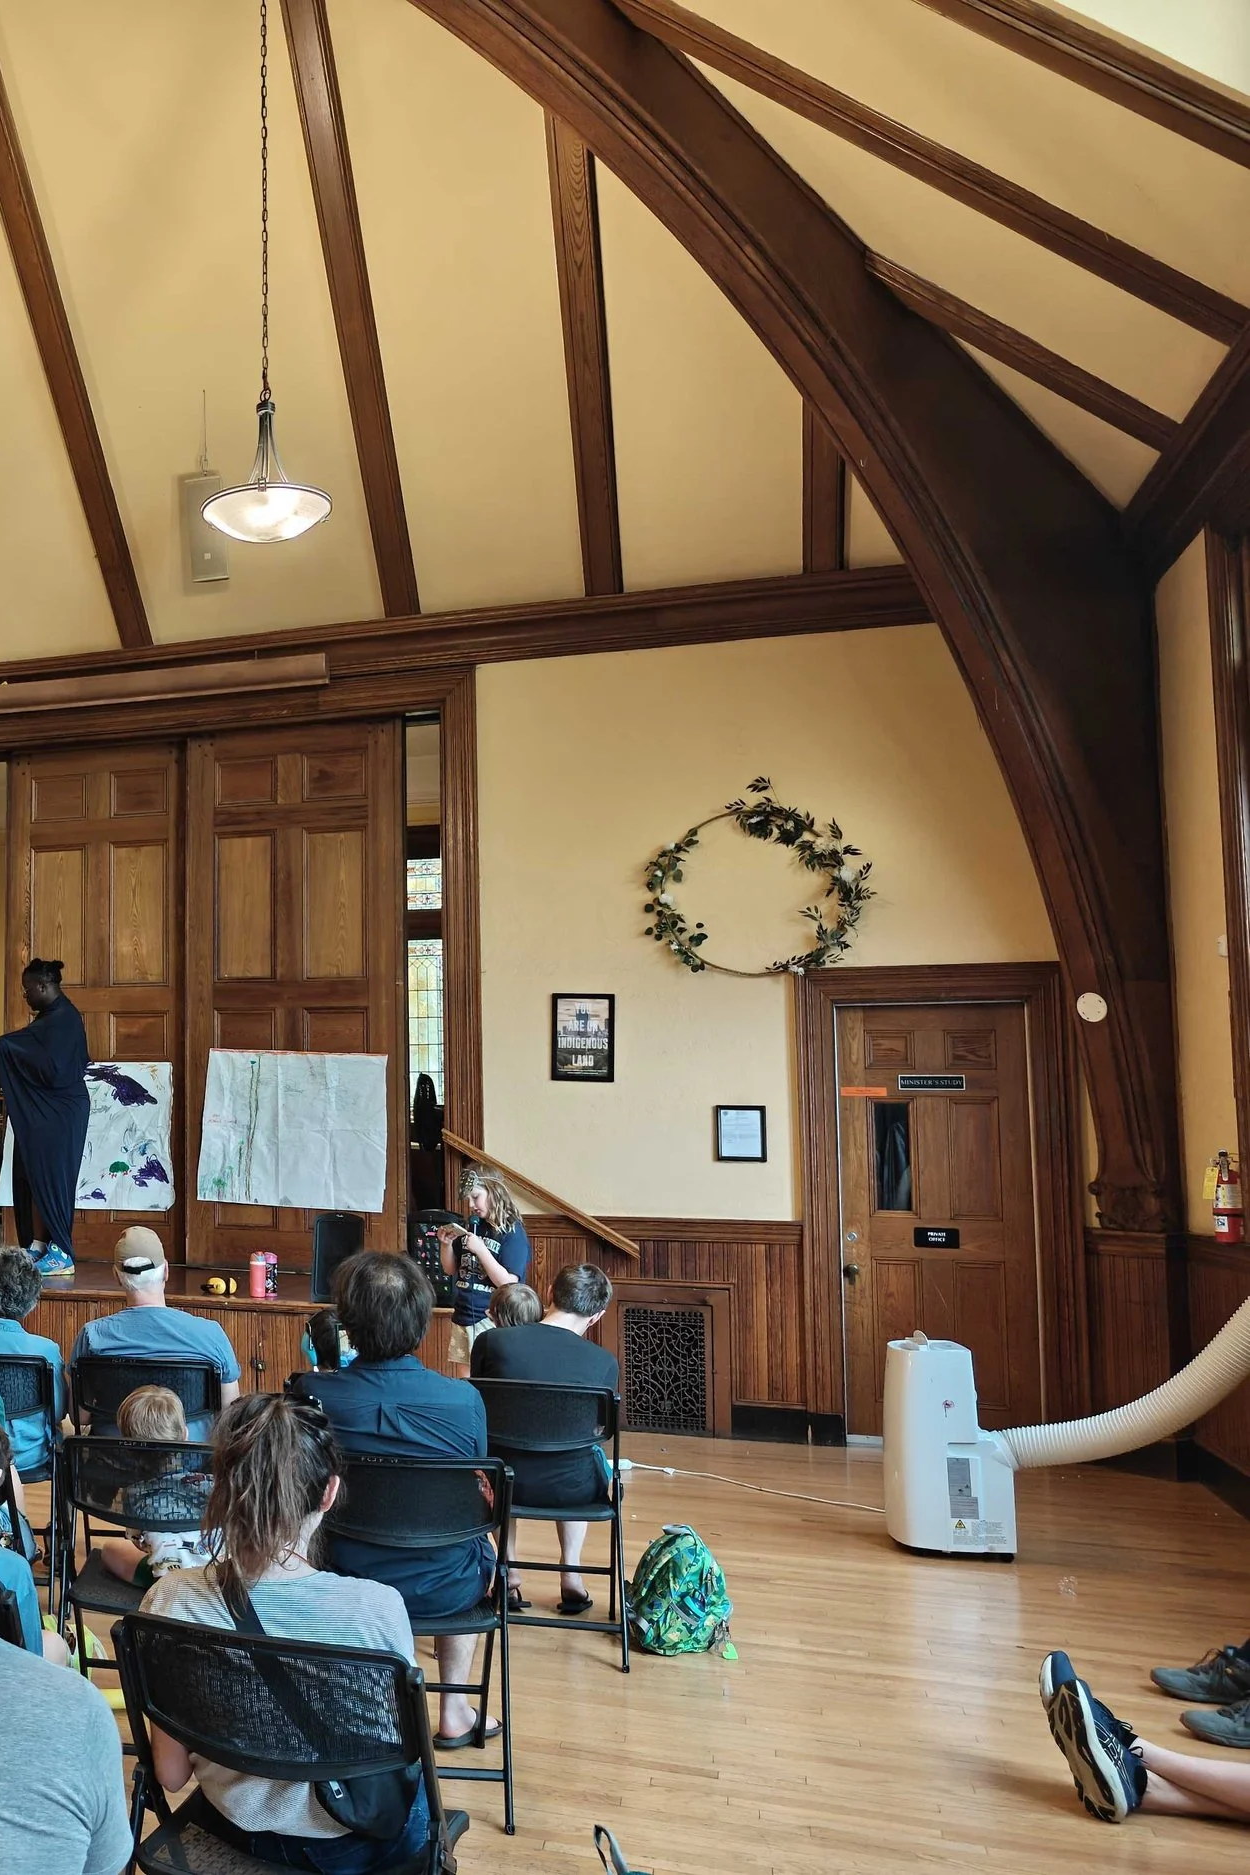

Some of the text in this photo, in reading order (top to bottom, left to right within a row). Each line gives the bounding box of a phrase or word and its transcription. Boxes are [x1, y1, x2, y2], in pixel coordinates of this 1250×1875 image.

[575, 1003, 591, 1014] YOU
[568, 1020, 585, 1031] ARE
[558, 1037, 608, 1049] INDIGENOUS
[572, 1055, 594, 1066] LAND
